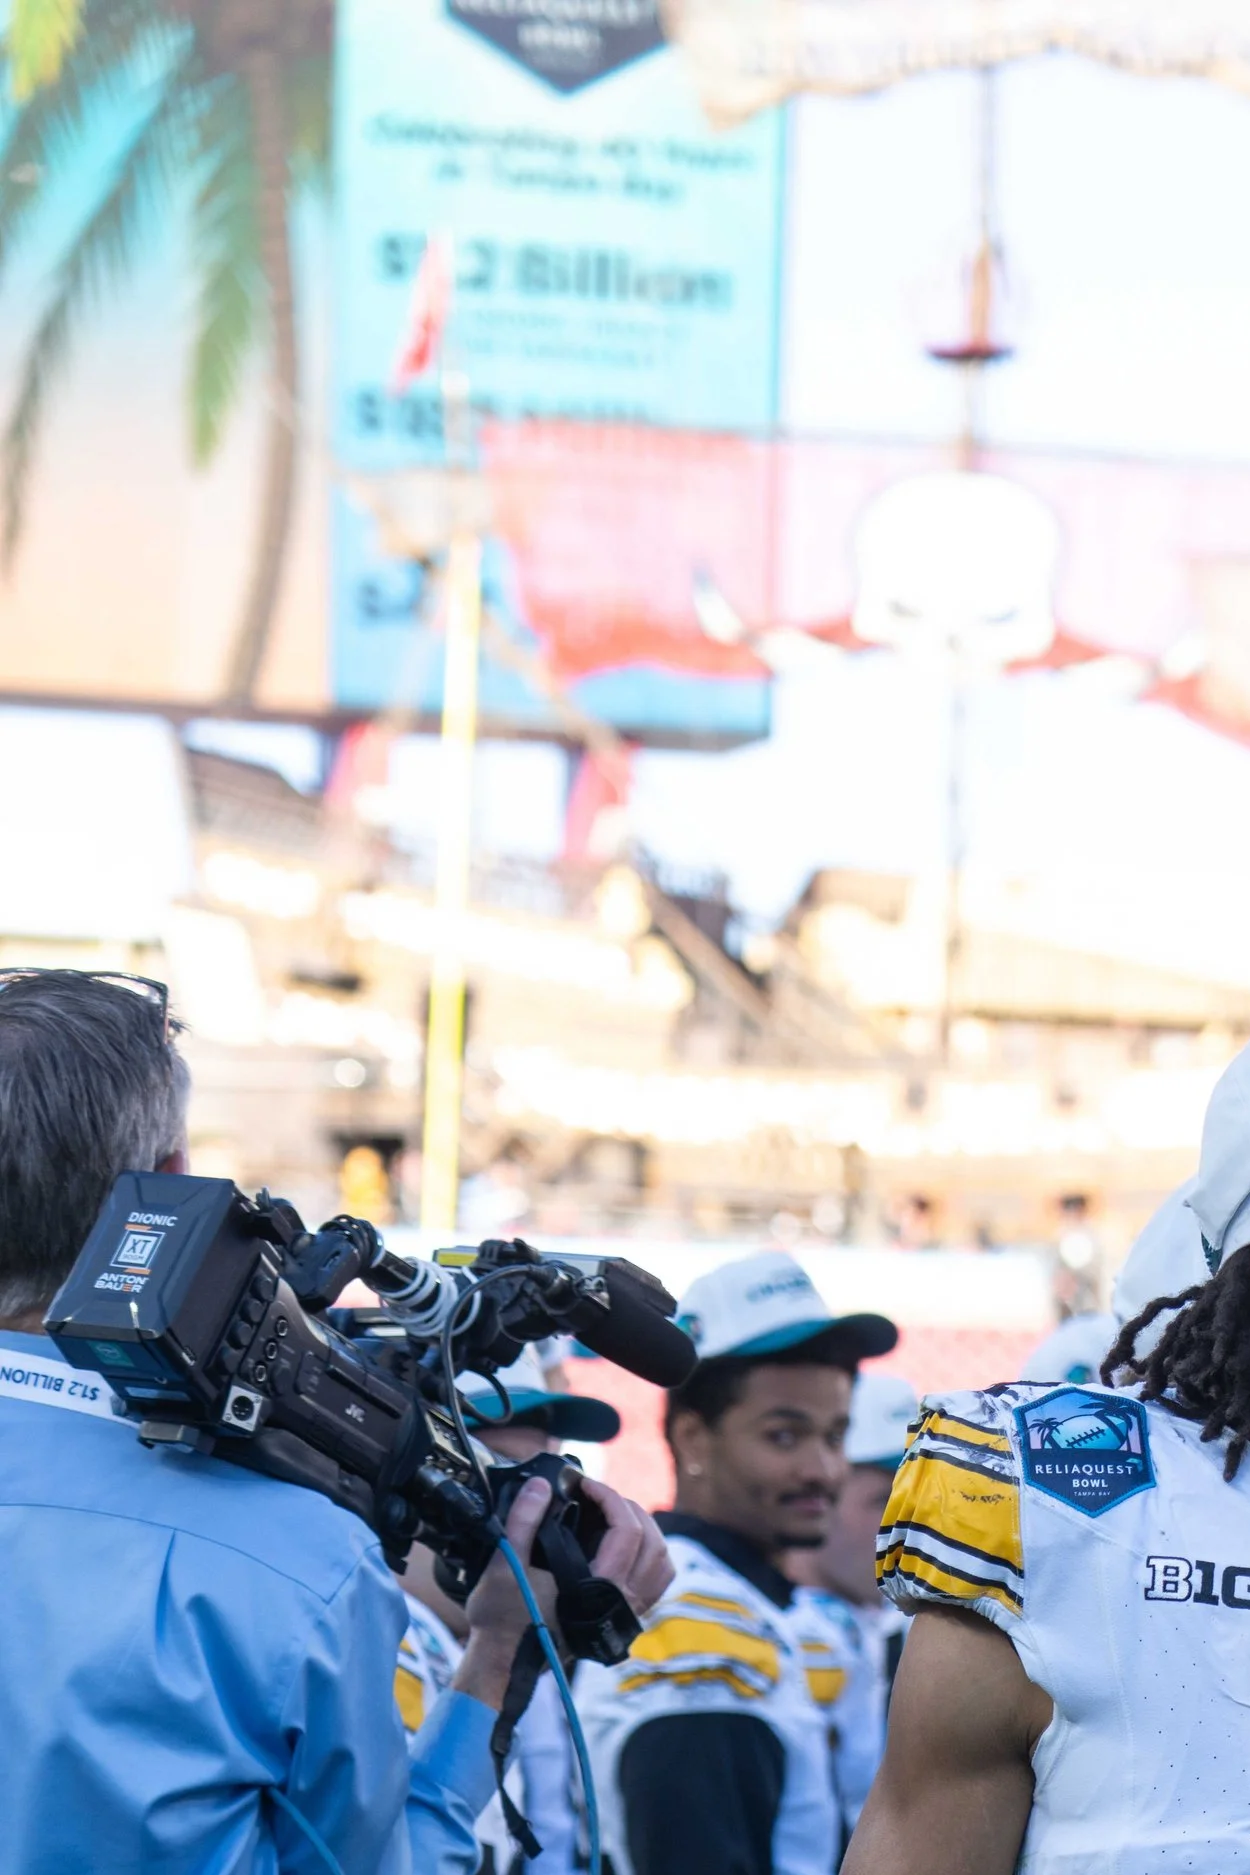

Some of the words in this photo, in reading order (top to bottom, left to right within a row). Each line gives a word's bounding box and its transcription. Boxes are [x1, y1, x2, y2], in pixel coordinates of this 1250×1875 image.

[127, 1211, 178, 1227] DIONIC
[127, 1238, 153, 1254] XT
[98, 1272, 149, 1285] ANTON
[93, 1280, 143, 1293] BAUER
[0, 1366, 65, 1392] BILLION
[68, 1380, 100, 1401] $1.2
[1035, 1463, 1134, 1476] RELIAQUEST
[1072, 1478, 1109, 1489] BOWL
